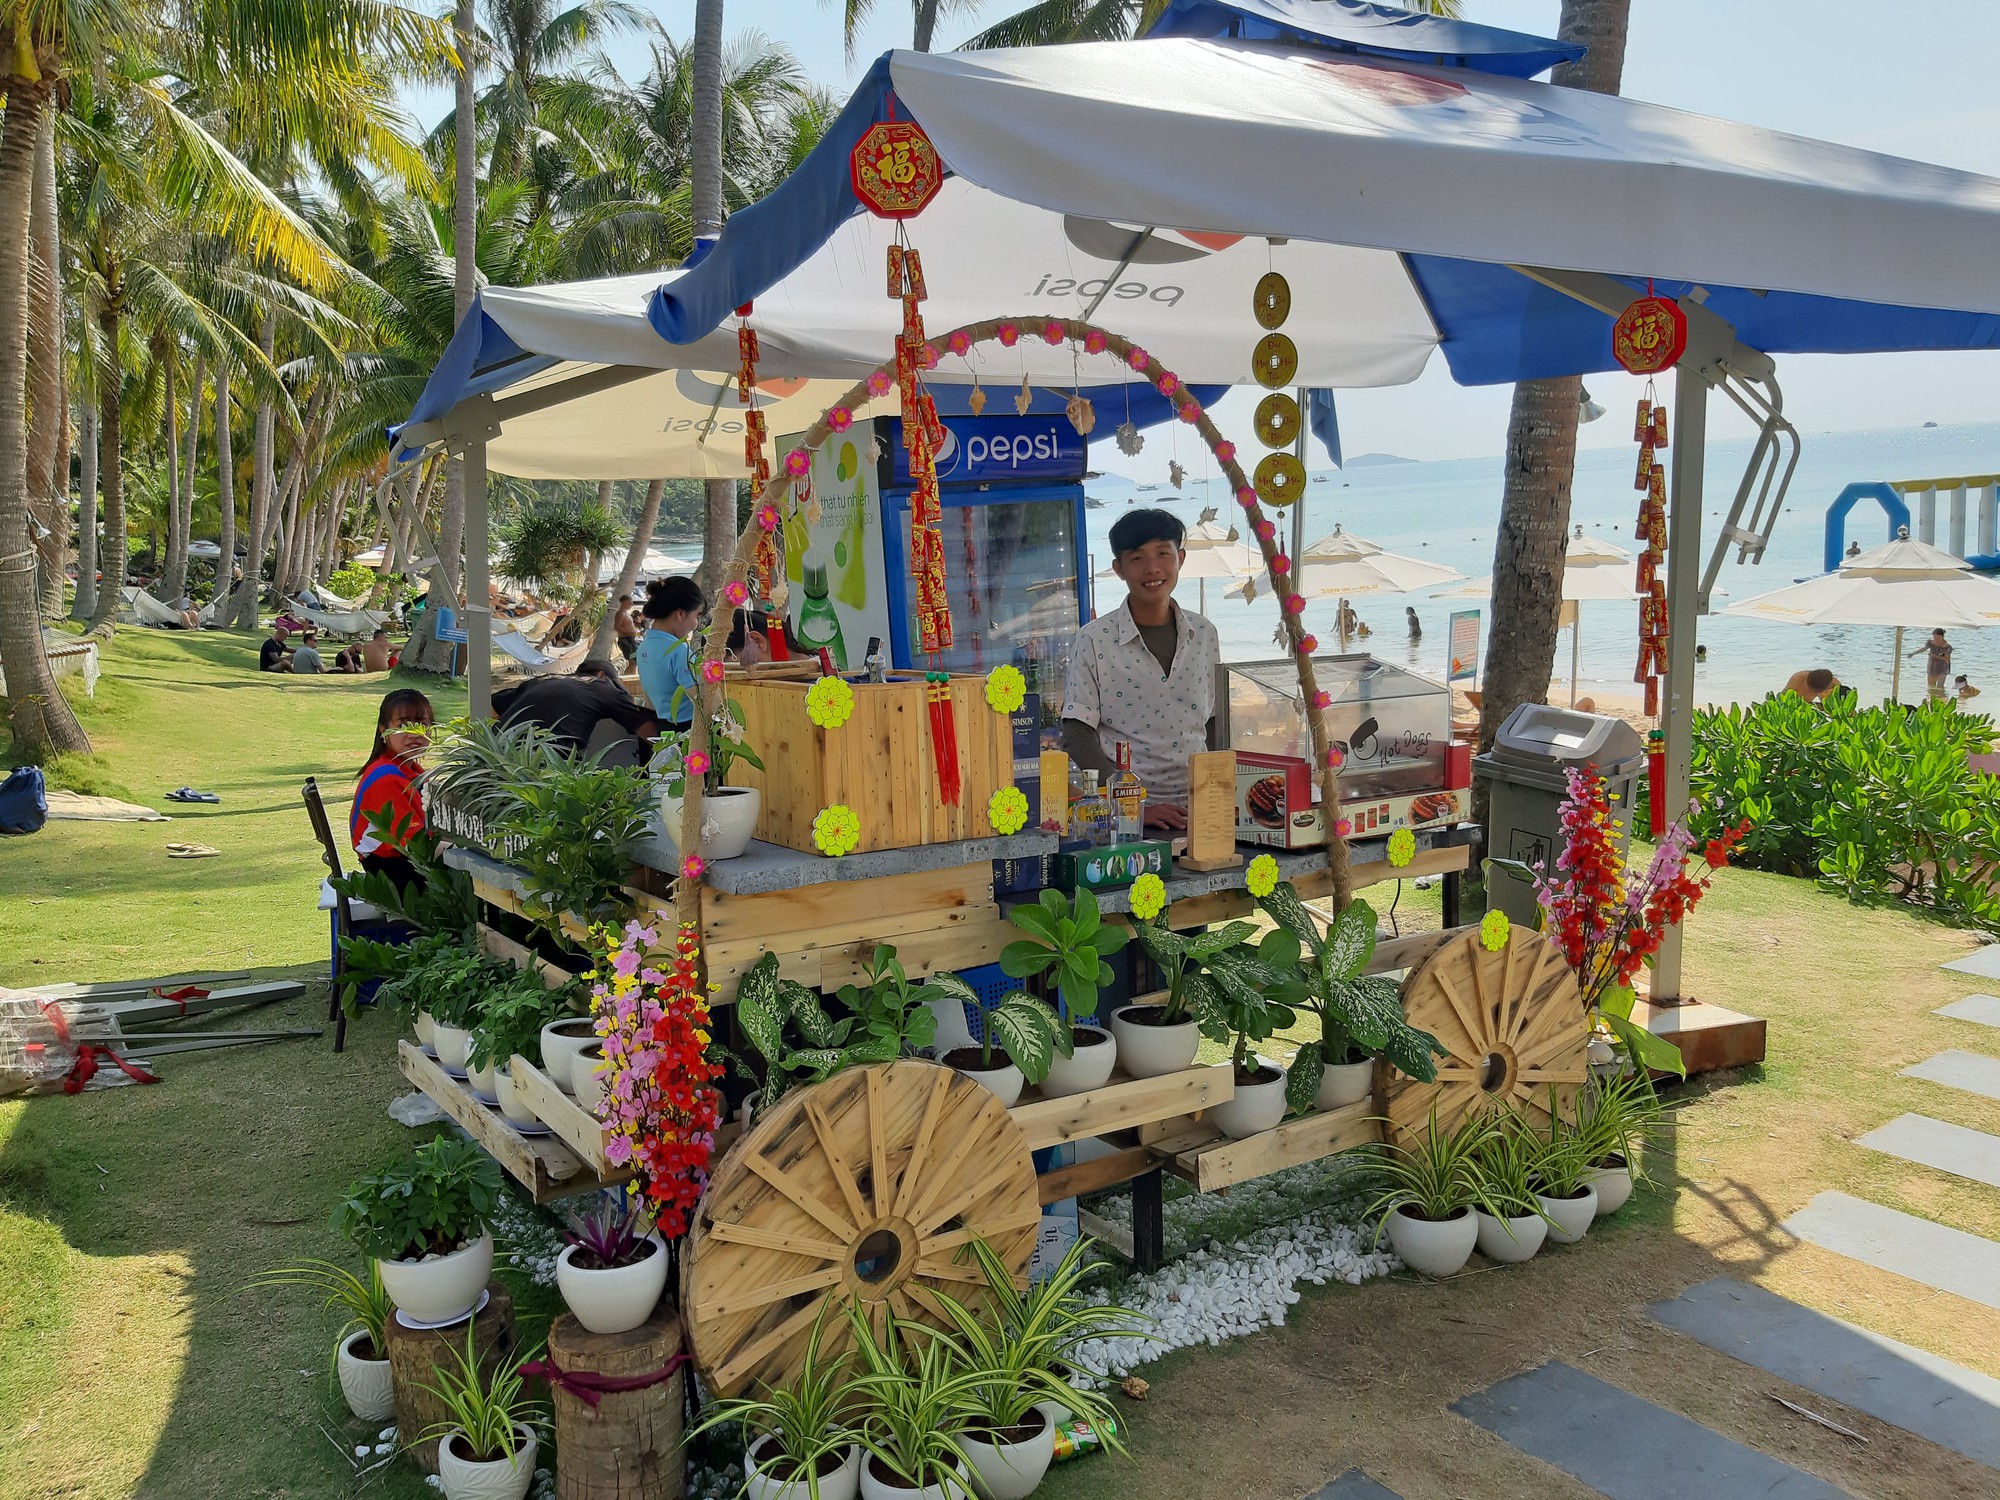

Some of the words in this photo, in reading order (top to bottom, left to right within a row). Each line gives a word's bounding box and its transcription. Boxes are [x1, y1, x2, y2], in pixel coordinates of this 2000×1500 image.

[876, 141, 916, 184] 福
[1630, 315, 1660, 349] 福
[967, 427, 1059, 471] pepsi
[1012, 717, 1033, 726] SIMSON
[1379, 739, 1401, 768] Hot
[1403, 729, 1431, 752] Dogs
[657, 776, 682, 785] Dasan
[432, 800, 452, 832] SUN
[1004, 860, 1012, 887] SIMSON
